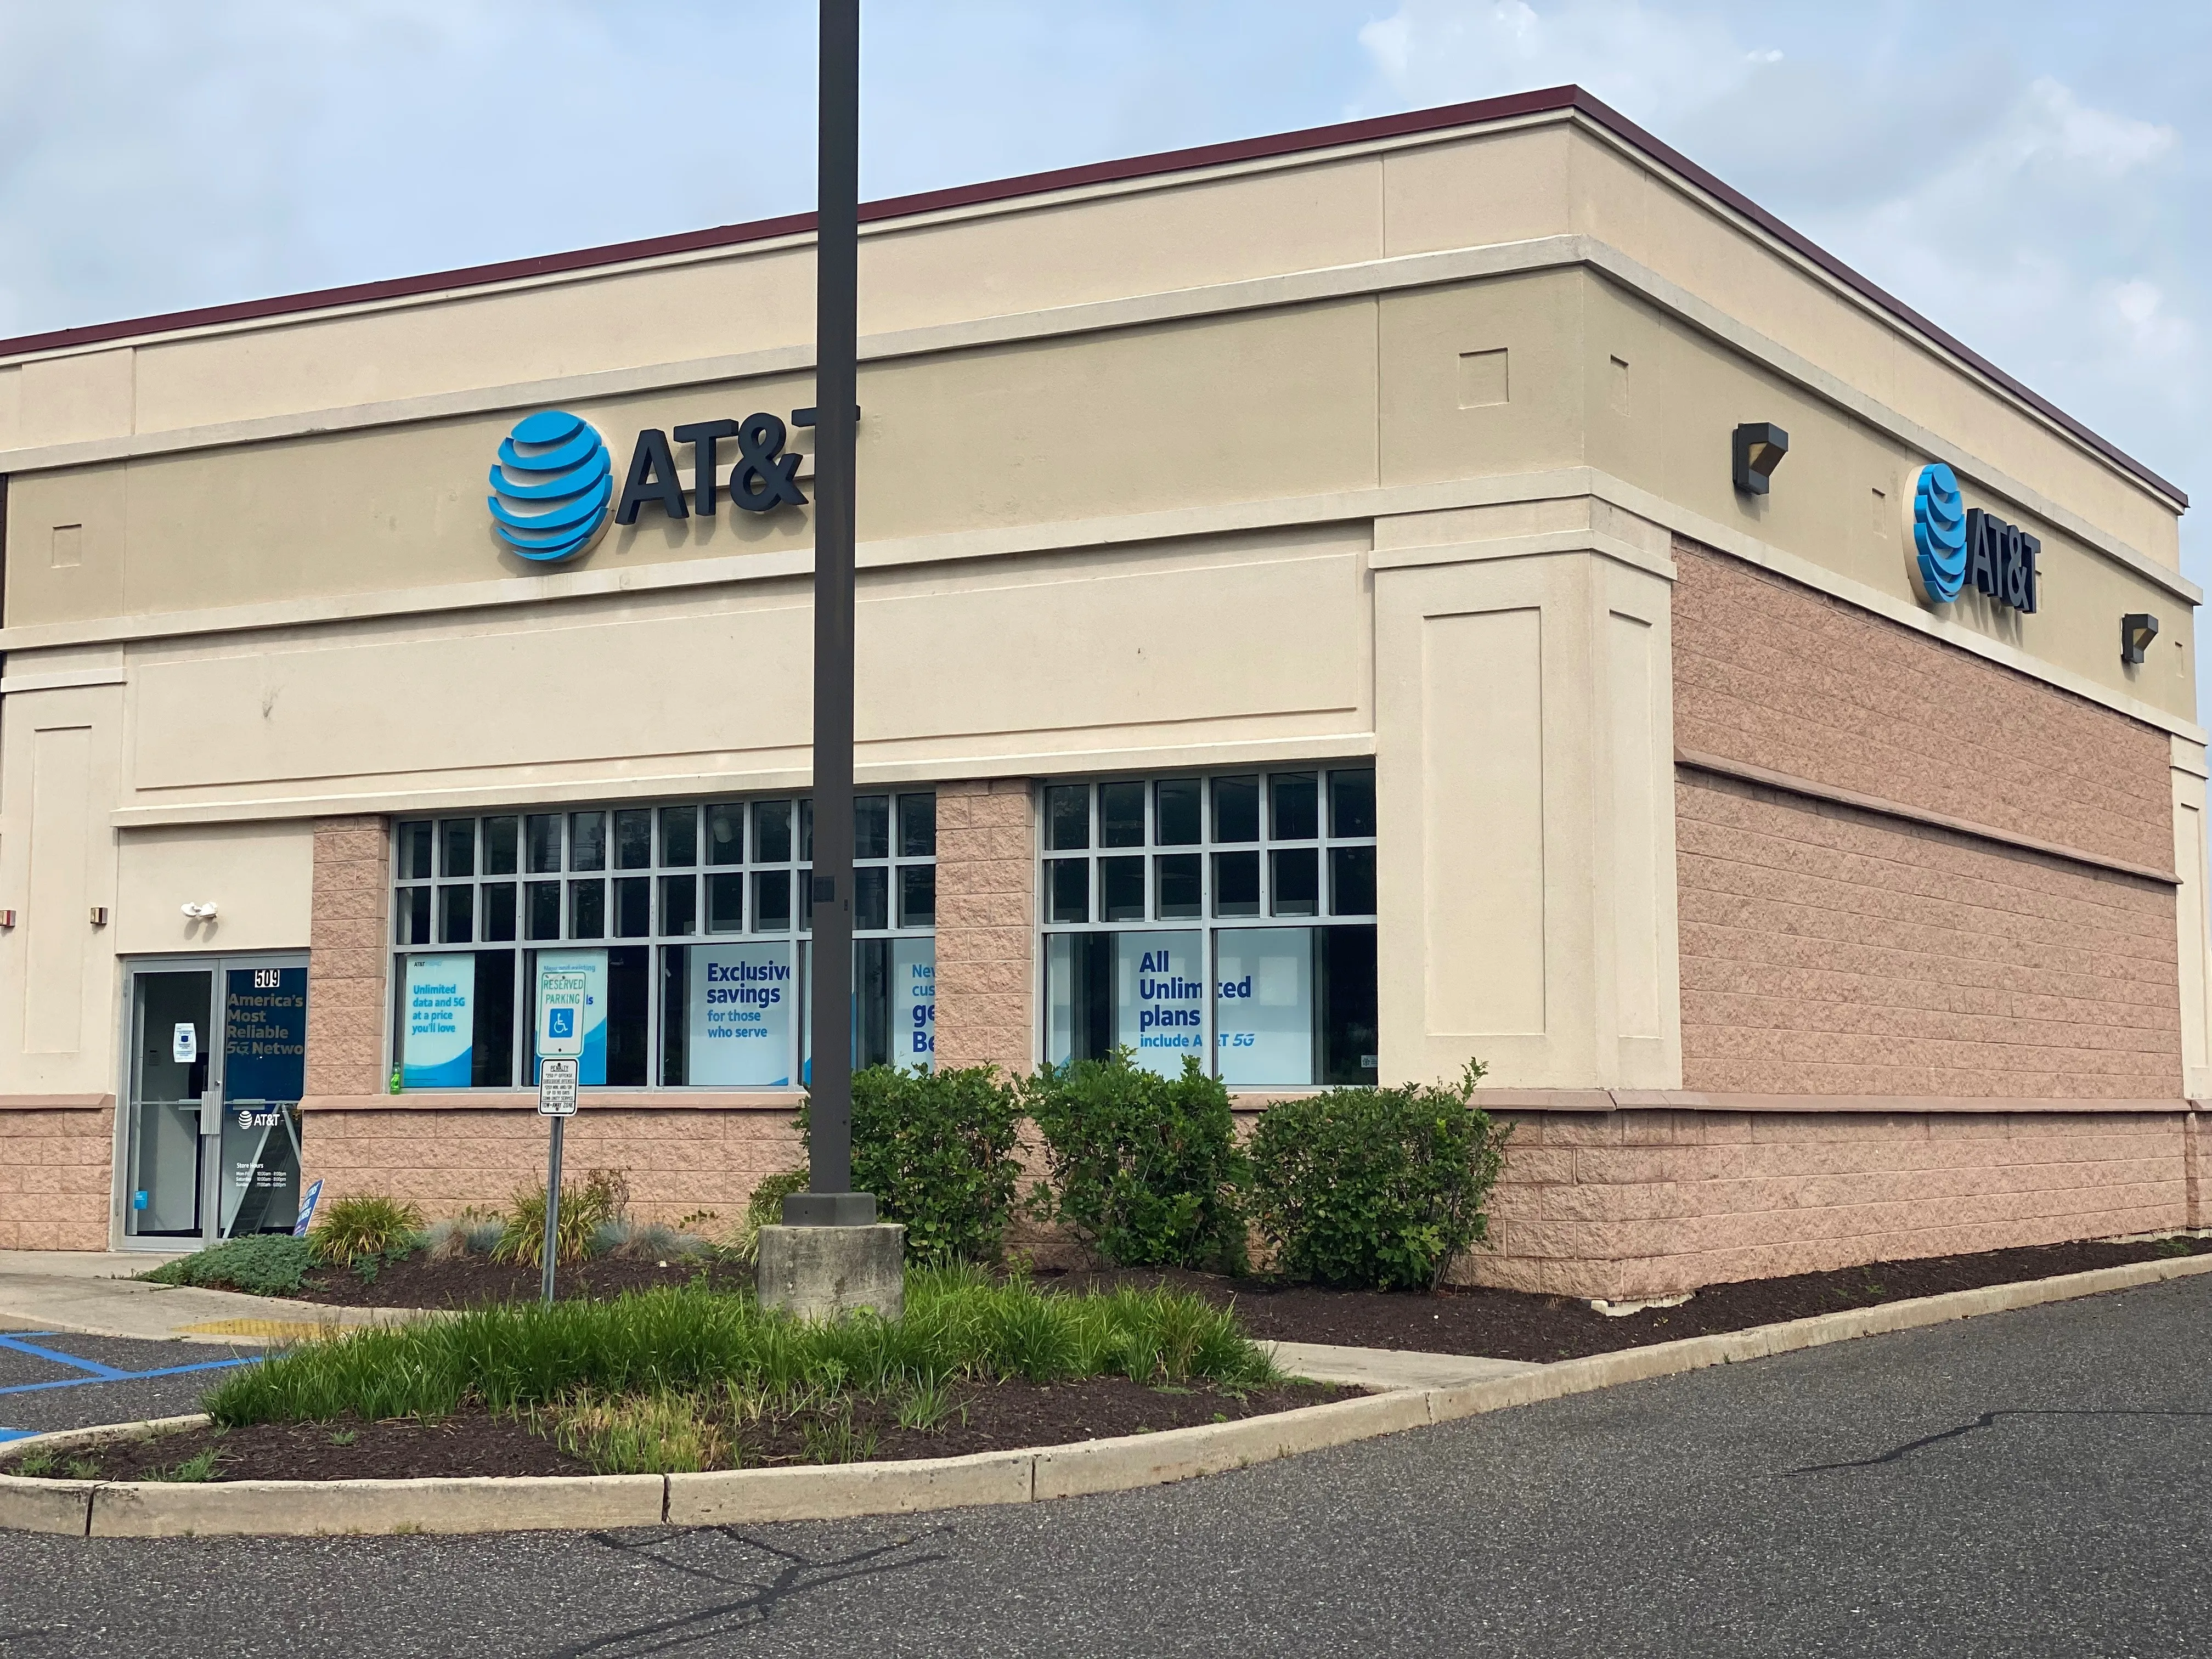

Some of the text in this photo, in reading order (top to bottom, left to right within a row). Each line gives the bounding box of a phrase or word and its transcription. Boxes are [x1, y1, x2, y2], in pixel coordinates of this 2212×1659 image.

[1963, 508, 2041, 614] AT&T
[1139, 950, 1169, 972] All
[912, 964, 935, 978] Ne
[256, 970, 278, 986] 509
[544, 979, 583, 990] RESERVED
[414, 984, 456, 994] Unlimited
[1140, 975, 1251, 999] Unlimed
[228, 993, 303, 1007] America's
[413, 997, 465, 1007] data and 5G
[546, 994, 580, 1004] PARKING
[707, 983, 780, 1008] savings
[228, 1009, 267, 1022] Most
[413, 1011, 421, 1019] at
[431, 1010, 453, 1022] price
[708, 1009, 761, 1022] for those
[1140, 1005, 1200, 1032] plans
[227, 1025, 289, 1039] Reliable
[412, 1023, 456, 1035] you'll love
[708, 1026, 767, 1037] who serve
[1141, 1034, 1255, 1047] include AT 5G
[227, 1042, 303, 1055] 5G Netwo
[253, 1114, 280, 1126] AT&T
